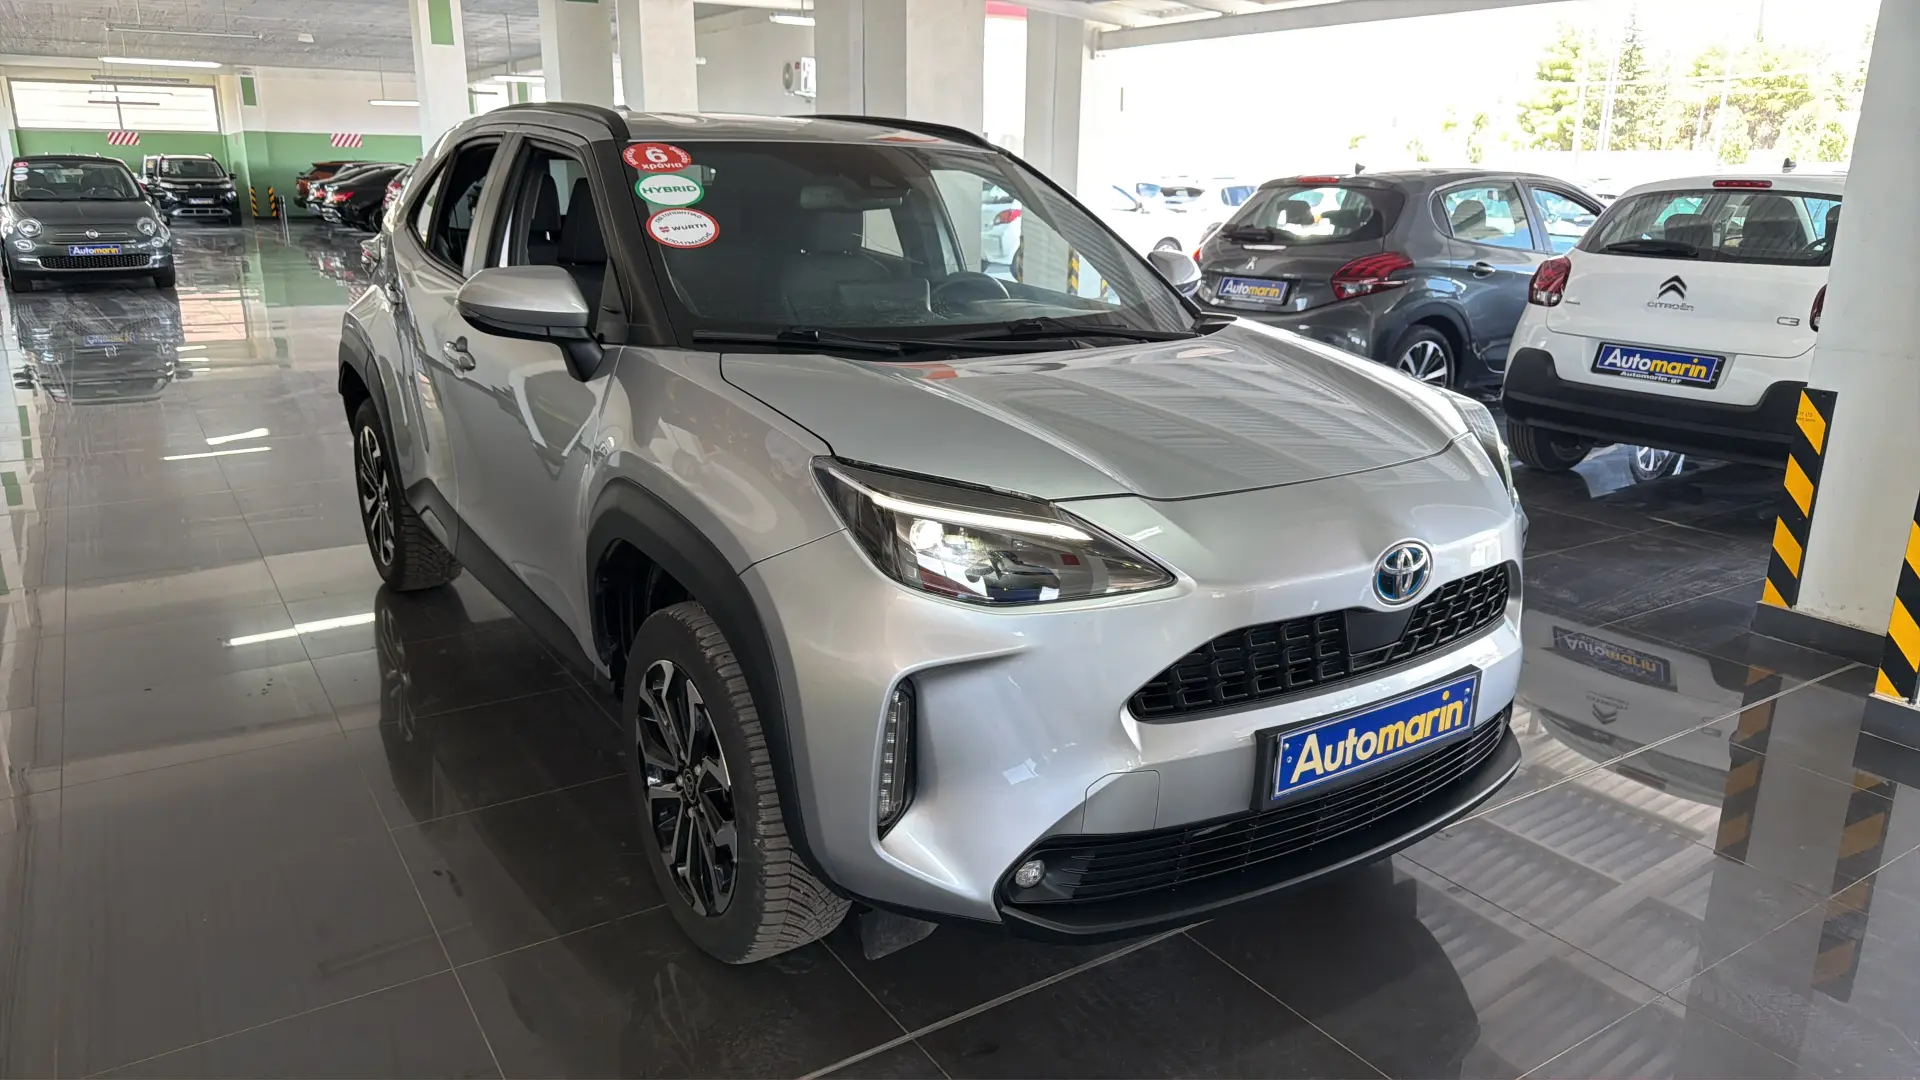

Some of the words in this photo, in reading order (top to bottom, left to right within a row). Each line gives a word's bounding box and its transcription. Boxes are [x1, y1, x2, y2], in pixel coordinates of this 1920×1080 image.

[645, 148, 668, 163] 6
[641, 185, 697, 194] HYBRID
[73, 246, 118, 255] Automarin
[1223, 280, 1280, 297] Automarin
[1776, 316, 1801, 326] C3
[1603, 348, 1707, 379] Automarin
[1620, 371, 1682, 384] Automarin.gr
[1289, 690, 1464, 784] Automarin
